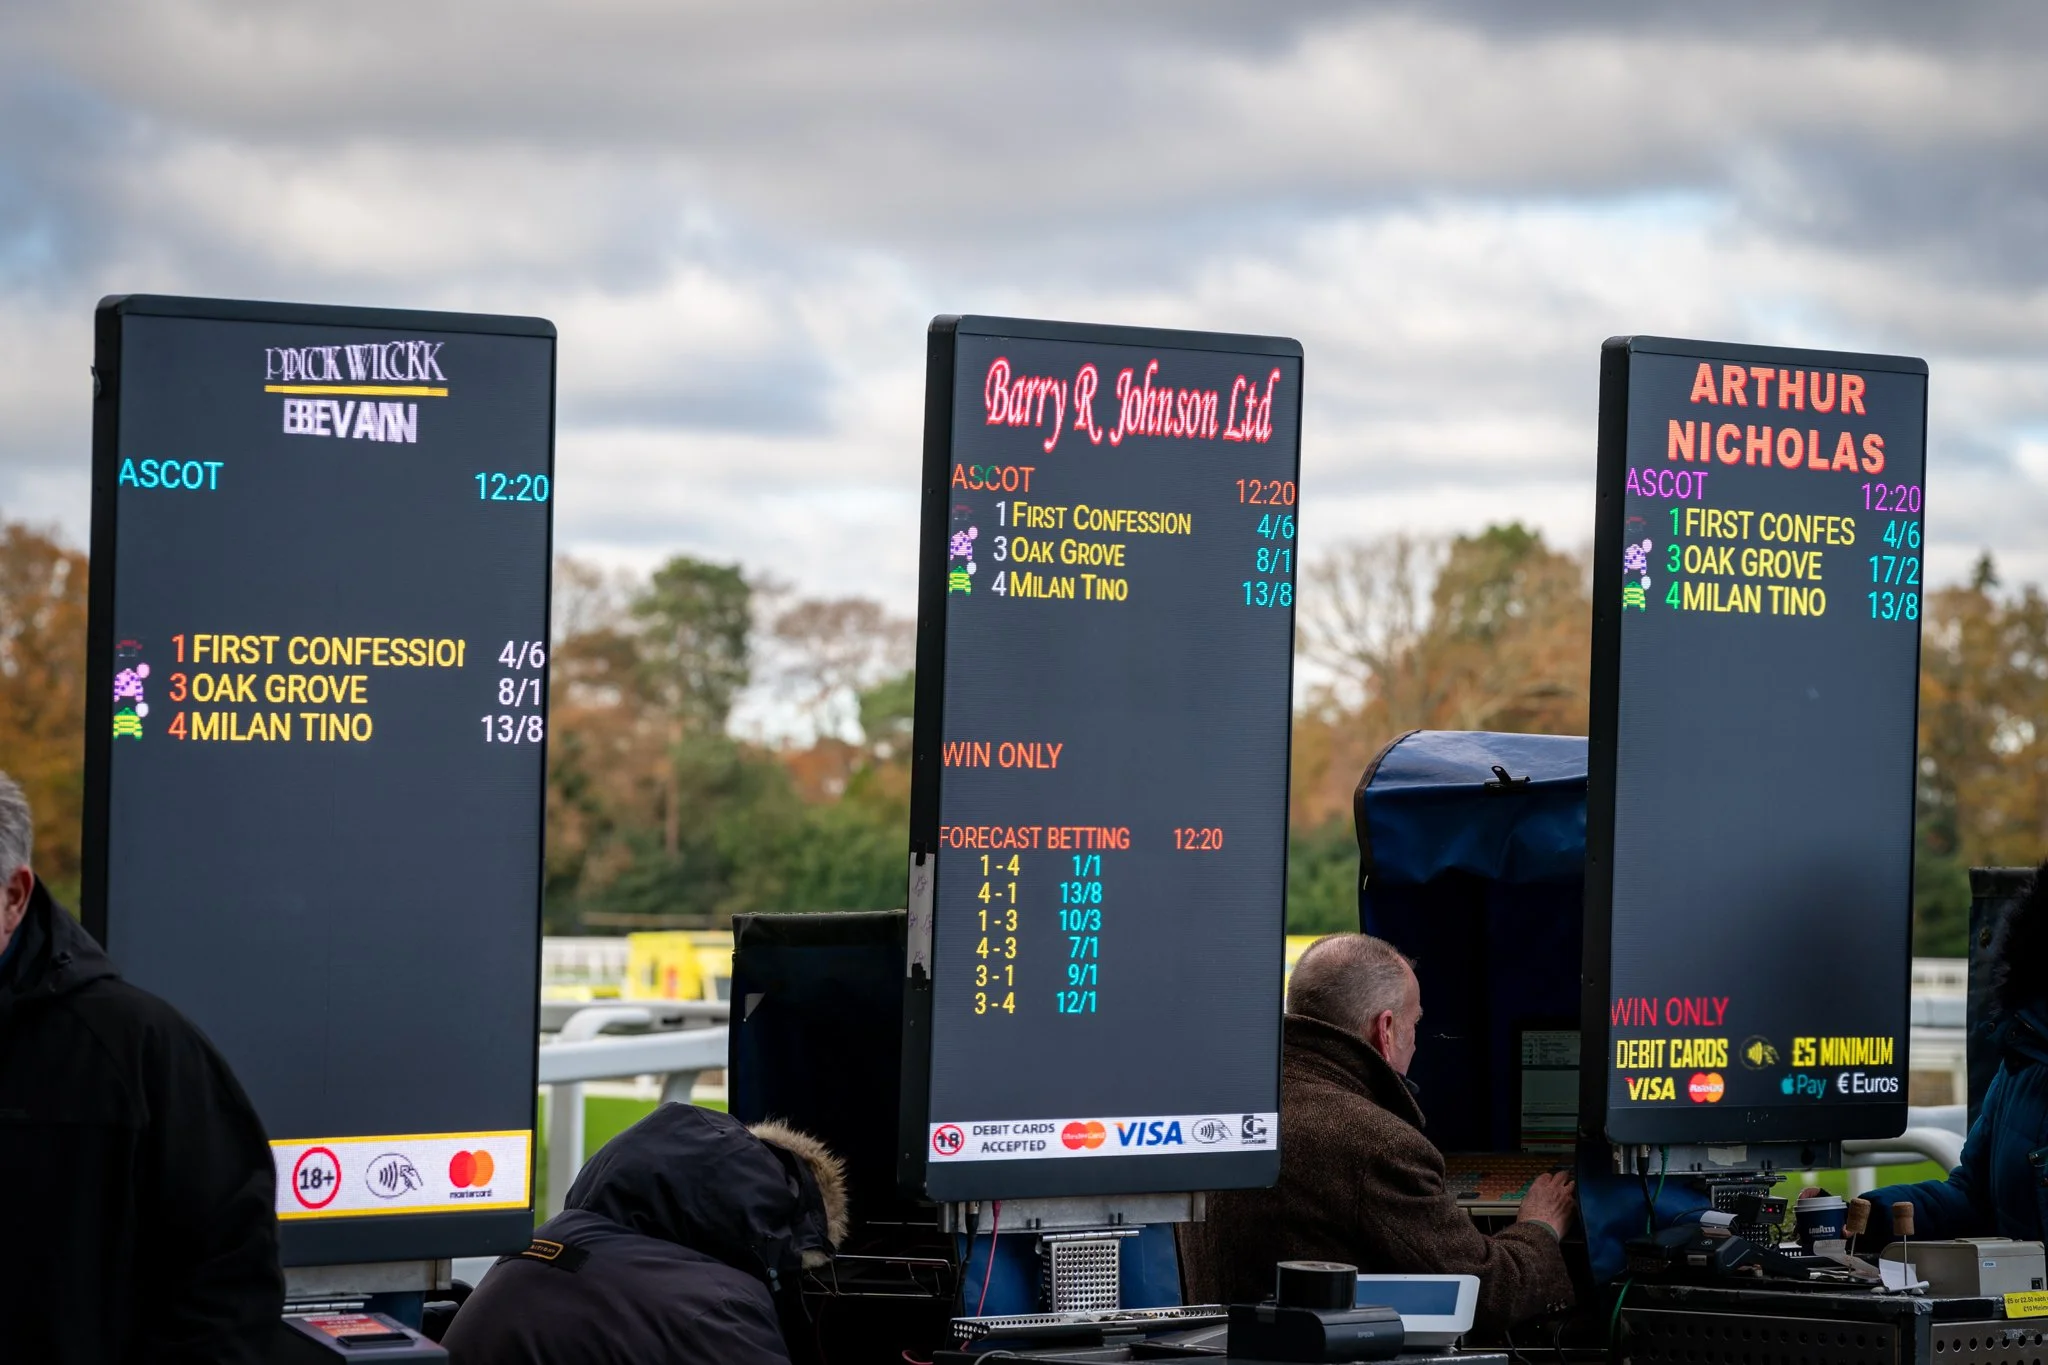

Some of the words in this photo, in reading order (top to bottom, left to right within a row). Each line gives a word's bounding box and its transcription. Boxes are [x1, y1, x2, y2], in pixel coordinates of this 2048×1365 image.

[1690, 363, 1866, 415] ARTHUR
[984, 357, 1067, 453] Barry
[1074, 363, 1102, 445] R
[1108, 359, 1219, 446] Johnson
[1223, 368, 1280, 443] Ltd
[1667, 420, 1884, 473] NICHOLAS
[119, 459, 224, 489] ASCOT
[475, 473, 548, 501] 12:20
[952, 464, 1035, 492] ASCOT
[1627, 468, 1708, 499] ASCOT
[1236, 478, 1295, 505] 12:20
[1862, 483, 1922, 512] 12:20
[996, 501, 1005, 526] 1
[1257, 514, 1295, 541] 4/6
[1670, 508, 1678, 535] 1
[1686, 508, 1754, 539] FIRST
[1760, 513, 1855, 545] CONFES
[994, 536, 1007, 561] 3
[1883, 520, 1920, 549] 4/6
[1257, 548, 1289, 573] 8/1
[1667, 544, 1680, 572] 3
[1685, 545, 1735, 575] OAK
[1741, 548, 1822, 580] GROVE
[1870, 556, 1919, 585] 17/2
[992, 571, 1006, 596] 4
[1243, 581, 1292, 607] 13/8
[1666, 581, 1680, 609] 4
[1684, 582, 1761, 613] MILAN
[1768, 585, 1826, 616] TINO
[1868, 591, 1919, 620] 13/8
[172, 634, 184, 662] 1
[194, 635, 280, 664] FIRST
[499, 641, 546, 670] 4/6
[170, 673, 187, 701] 3
[193, 673, 257, 702] OAK
[265, 675, 368, 703] GROVE
[499, 678, 539, 706] 8/1
[168, 712, 187, 740] 4
[192, 712, 290, 741] MILAN
[300, 713, 372, 741] TINO
[481, 712, 545, 744] 13/8
[944, 742, 990, 767] WIN
[998, 742, 1062, 768] ONLY
[940, 827, 1042, 848] FORECAST
[1048, 827, 1130, 849] BETTING
[1174, 828, 1223, 850] 12:20
[1073, 855, 1100, 876] 1/1
[1060, 882, 1102, 904] 13/8
[1060, 909, 1101, 931] 10/3
[1069, 936, 1098, 959] 7/1
[1068, 964, 1097, 986] 9/1
[1057, 991, 1096, 1013] 12/1
[1612, 998, 1657, 1026] WIN
[1665, 997, 1728, 1026] ONLY
[1617, 1040, 1666, 1068] DEBIT
[1670, 1038, 1728, 1068] CARDS
[1793, 1037, 1816, 1066] £5
[1820, 1037, 1893, 1066] MINIMUM
[1625, 1077, 1675, 1100] VISA
[1797, 1073, 1828, 1100] Pay
[1853, 1073, 1898, 1093] Euros
[973, 1125, 1008, 1135] DEBIT
[1013, 1123, 1055, 1134] CARDS
[1114, 1121, 1183, 1147] VISA
[981, 1140, 1046, 1153] ACCEPTED
[299, 1167, 335, 1191] 18+
